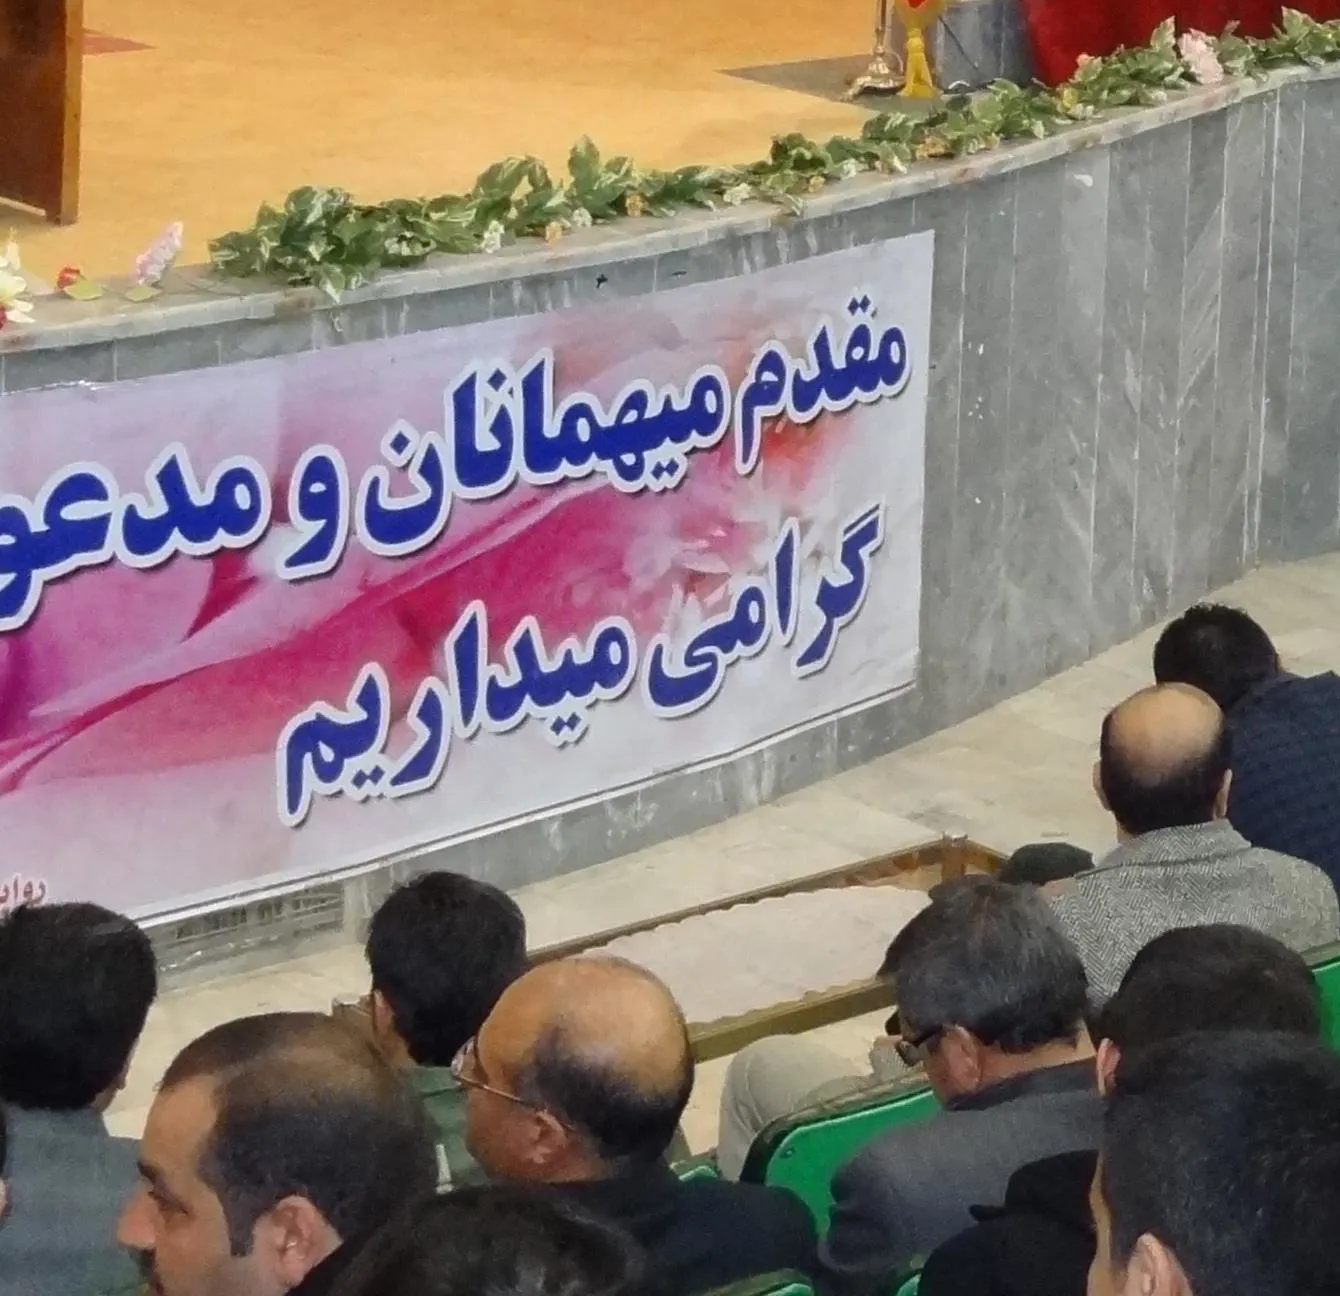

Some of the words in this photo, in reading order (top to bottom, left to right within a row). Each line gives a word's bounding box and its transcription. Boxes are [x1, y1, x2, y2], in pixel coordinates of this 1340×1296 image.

[362, 360, 726, 550] میهمانان
[739, 295, 907, 459] مقدم
[283, 453, 343, 570] و
[649, 510, 880, 706] گرامی
[285, 610, 630, 814] میداریم
